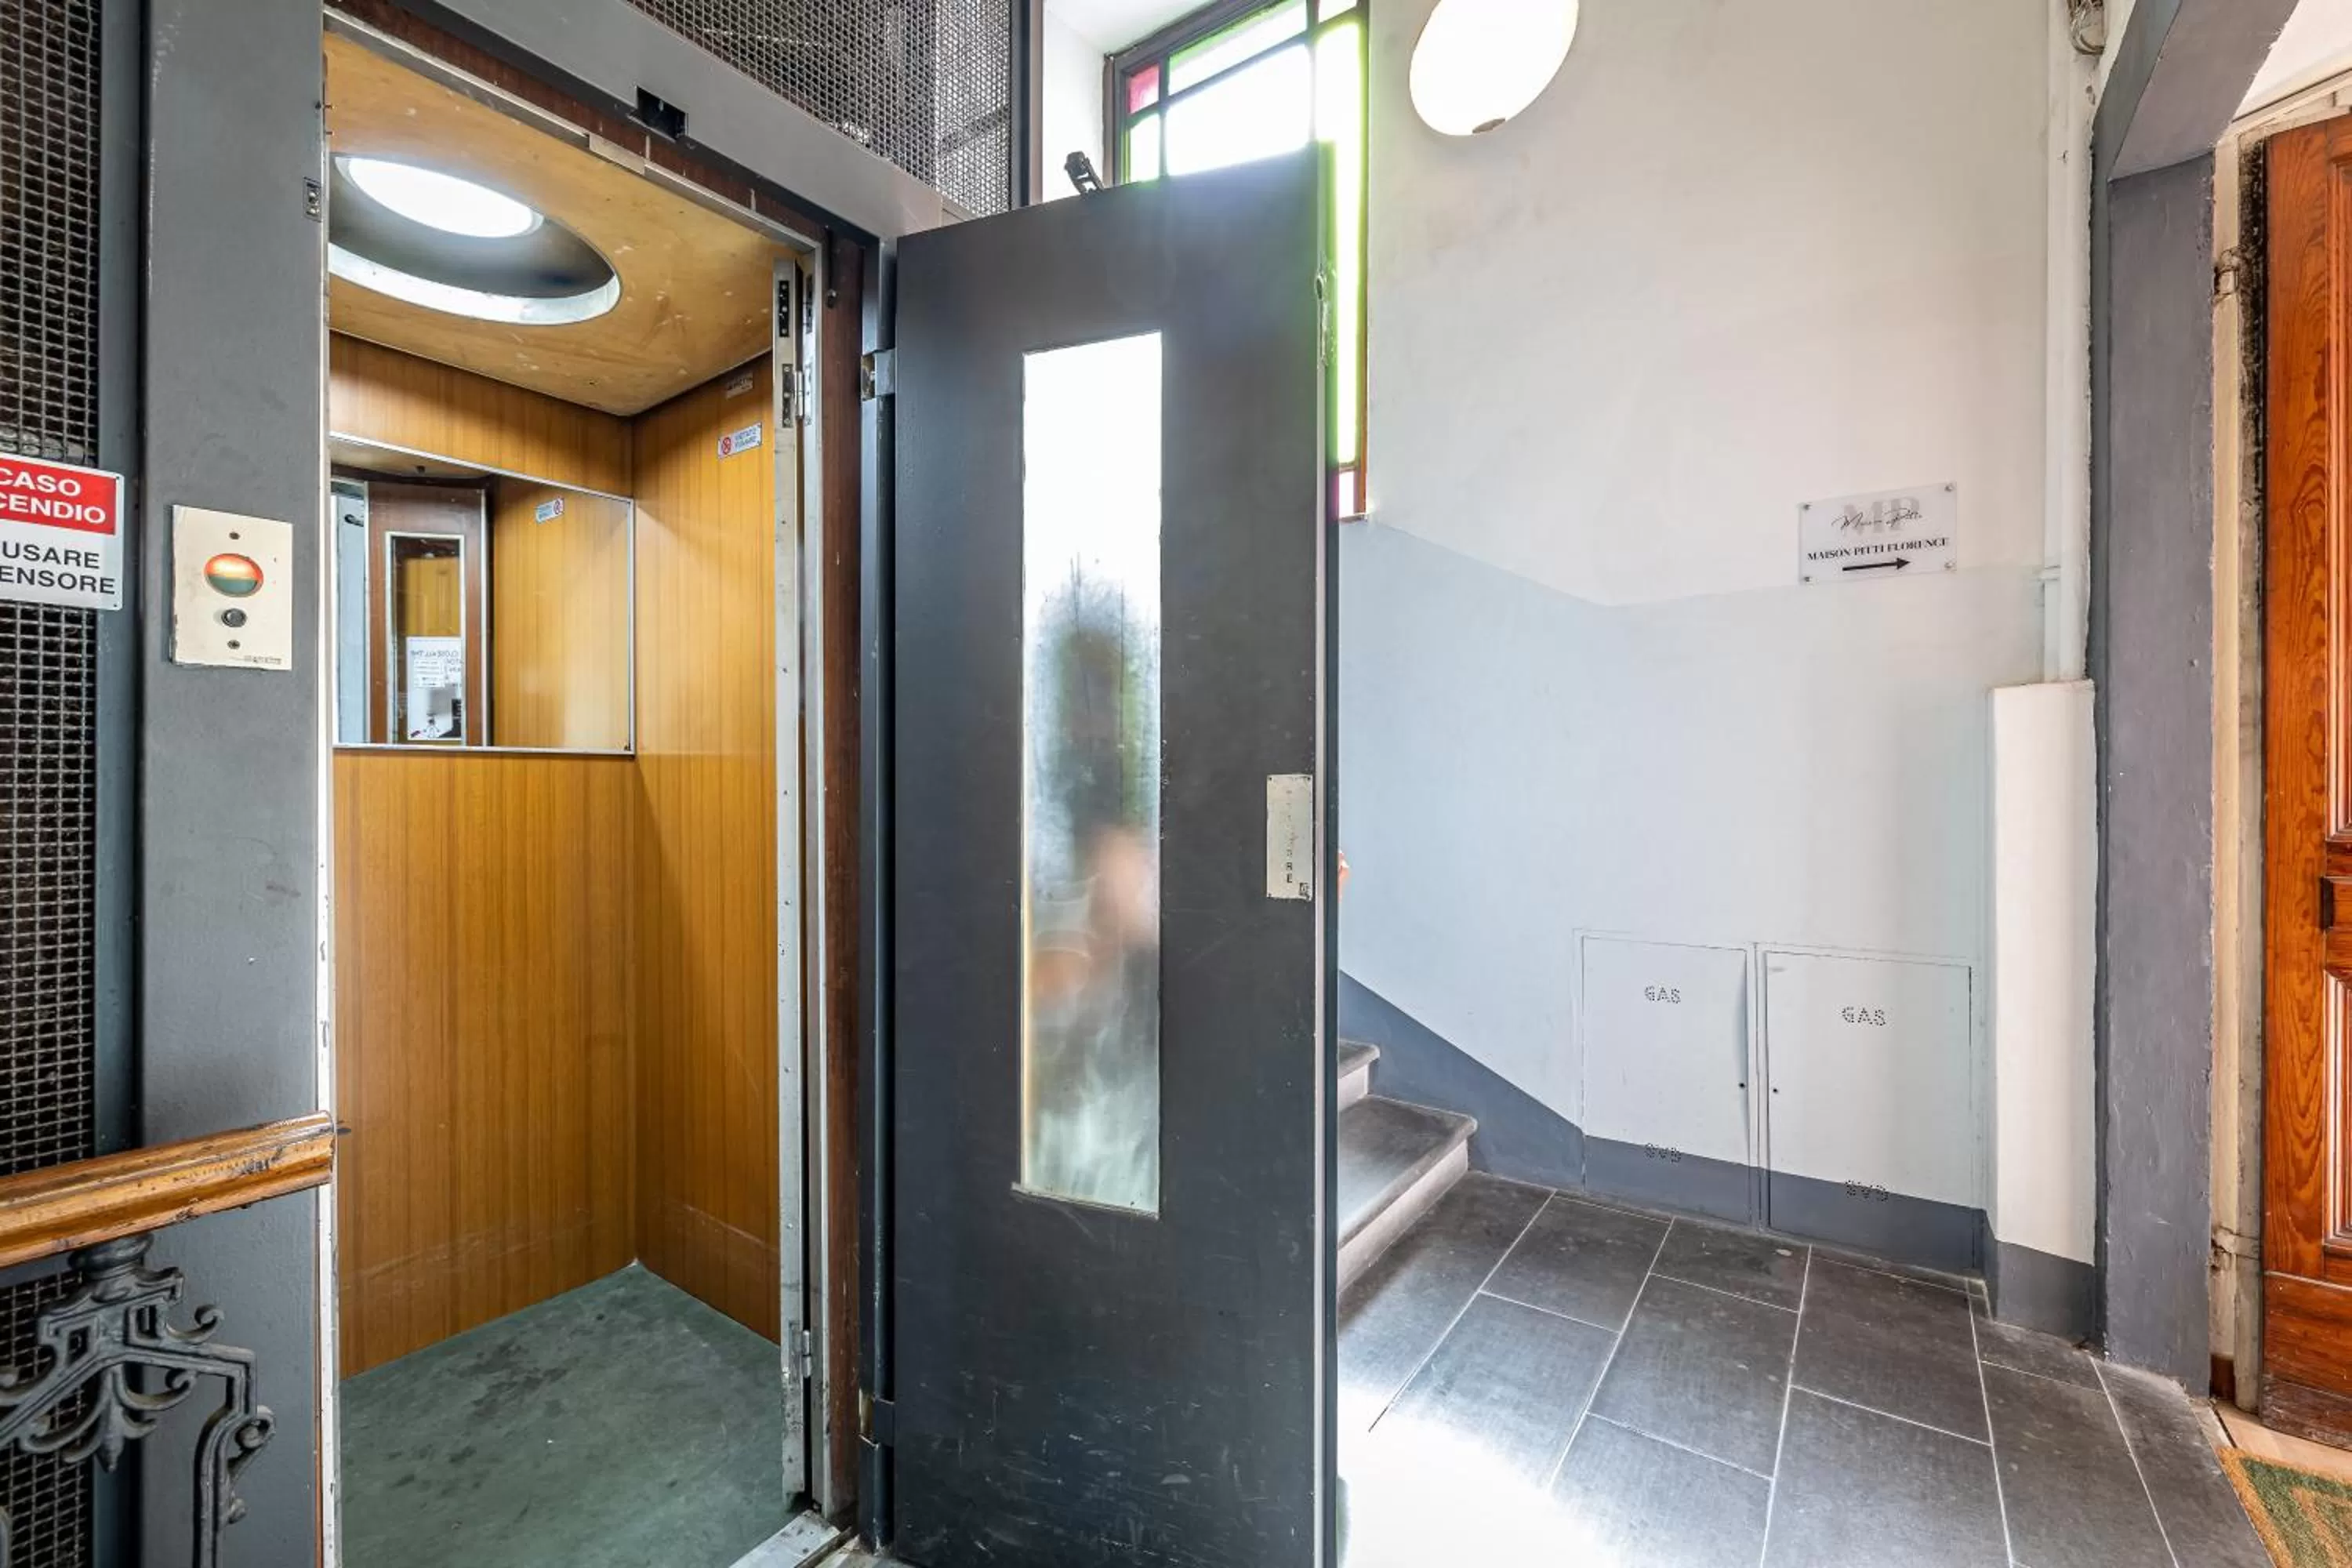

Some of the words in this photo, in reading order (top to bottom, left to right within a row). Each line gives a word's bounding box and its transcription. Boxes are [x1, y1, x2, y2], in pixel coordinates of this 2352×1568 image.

[2, 540, 100, 569] USARE
[1807, 548, 1851, 560] MAISON
[1853, 545, 1884, 556] PITTI
[1886, 537, 1950, 552] FLORENCE
[0, 564, 115, 595] ENSORE
[1644, 985, 1681, 1004] GAS
[1842, 1007, 1886, 1026] GAS
